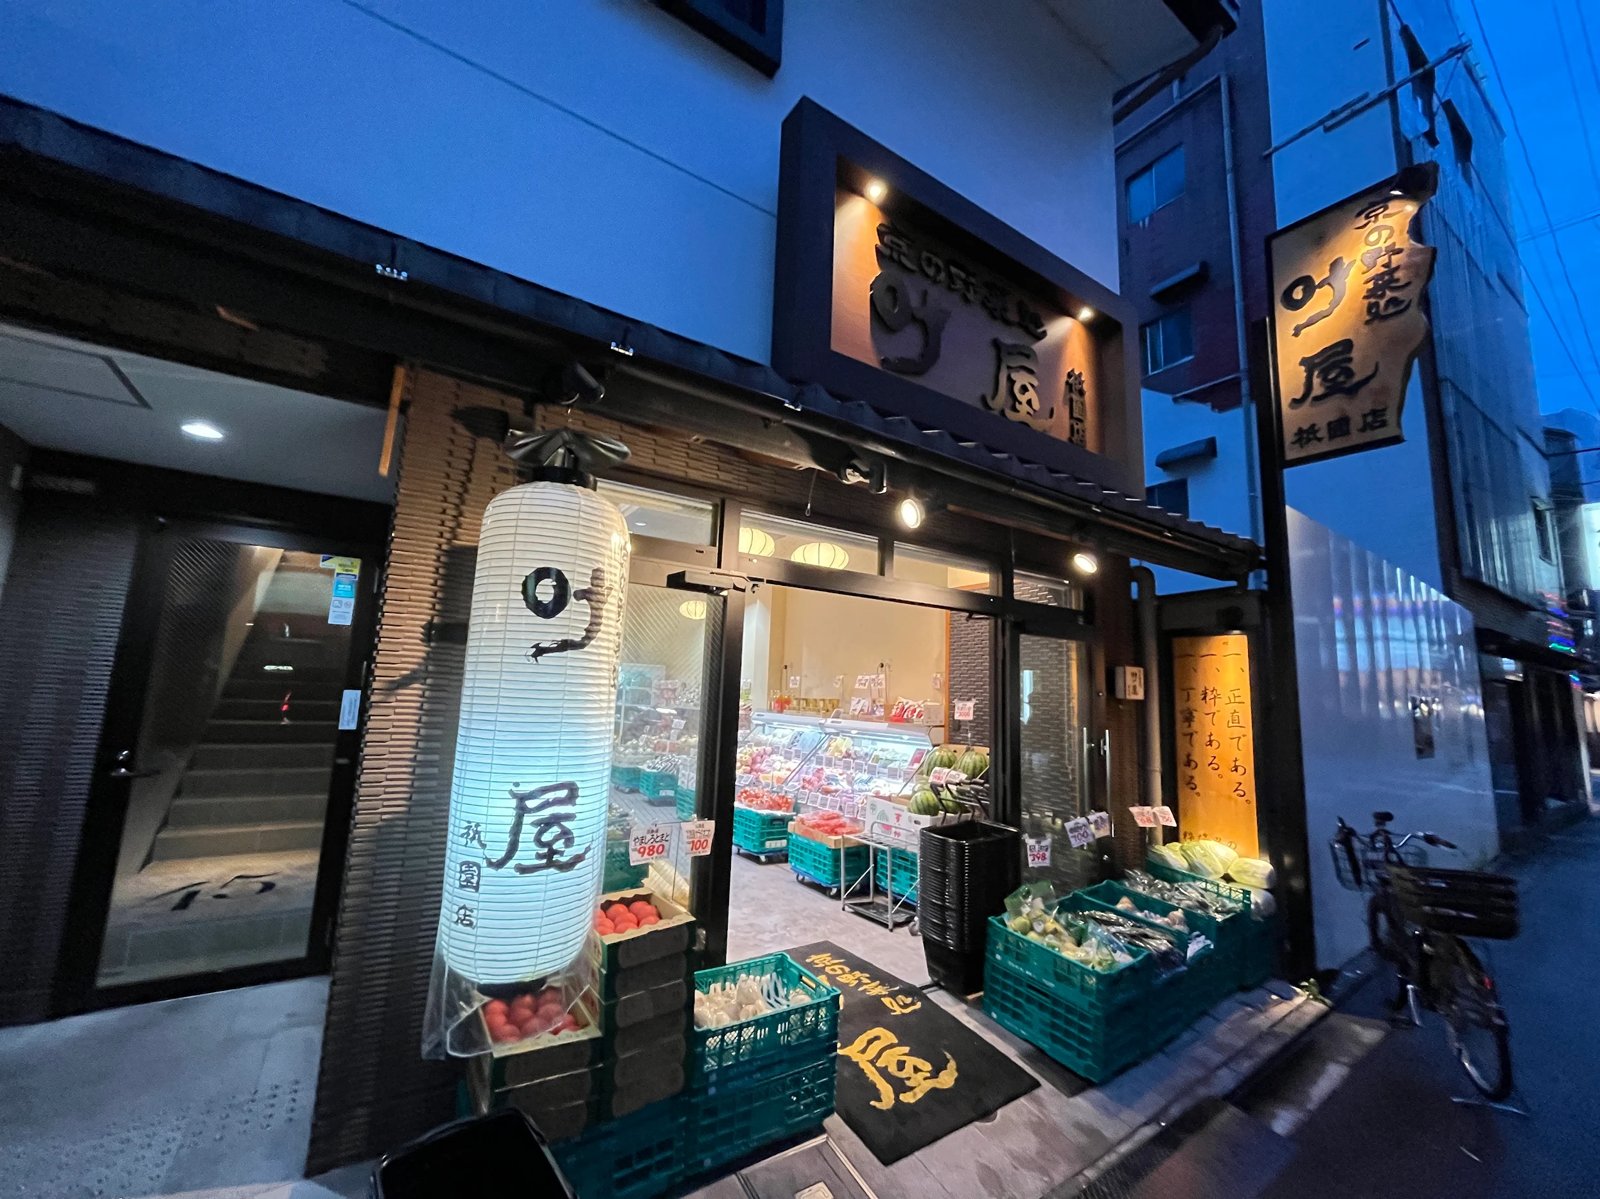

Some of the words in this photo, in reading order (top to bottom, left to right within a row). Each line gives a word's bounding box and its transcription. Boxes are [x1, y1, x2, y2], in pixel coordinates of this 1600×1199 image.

[1355, 201, 1412, 325] 京の野菜処
[1199, 652, 1224, 780] 一、粋である。
[1223, 652, 1252, 804] 一、正直である。
[637, 843, 665, 858] 980
[690, 839, 708, 852] 100
